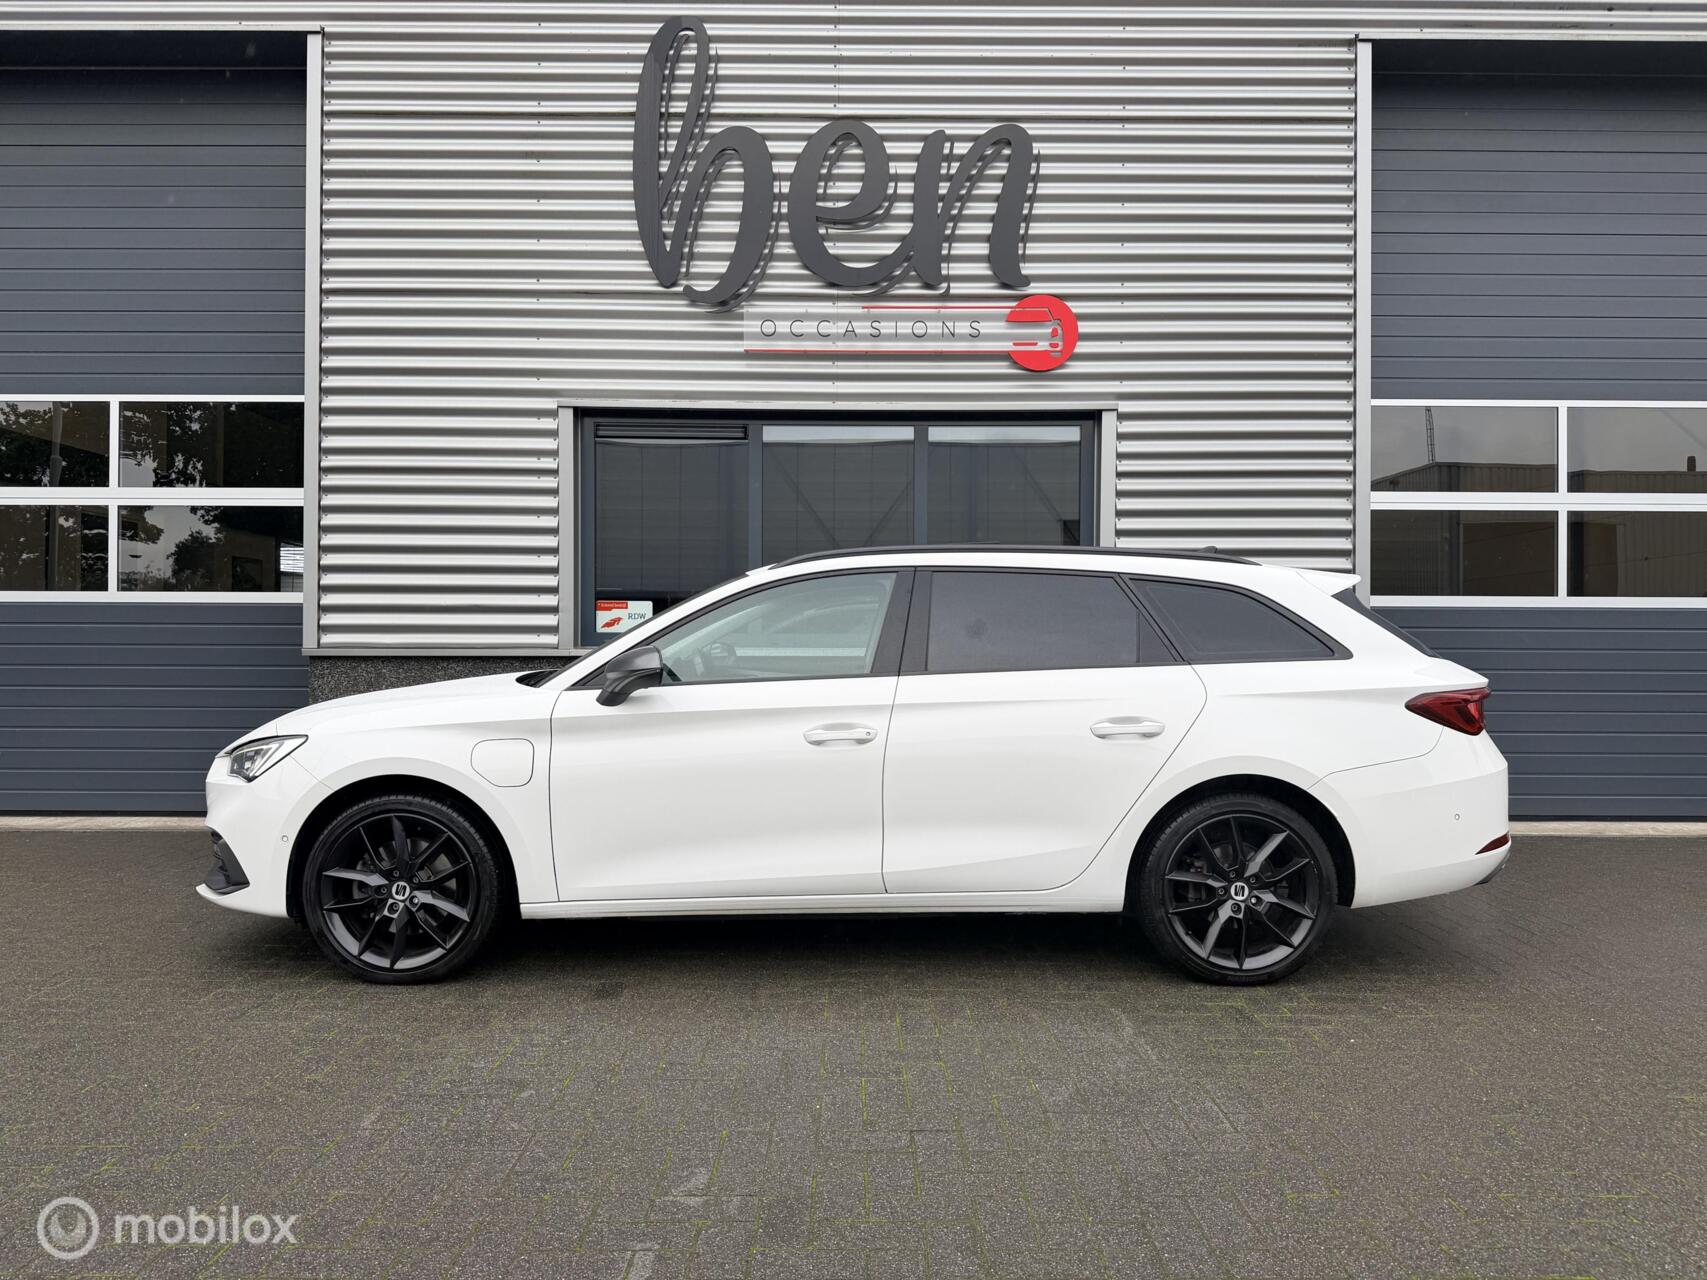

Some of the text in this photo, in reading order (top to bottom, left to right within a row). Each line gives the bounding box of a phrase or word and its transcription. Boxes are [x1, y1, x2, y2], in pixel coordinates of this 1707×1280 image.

[632, 15, 1032, 305] ben
[759, 318, 984, 339] OCCASIONS
[627, 612, 647, 620] RDW
